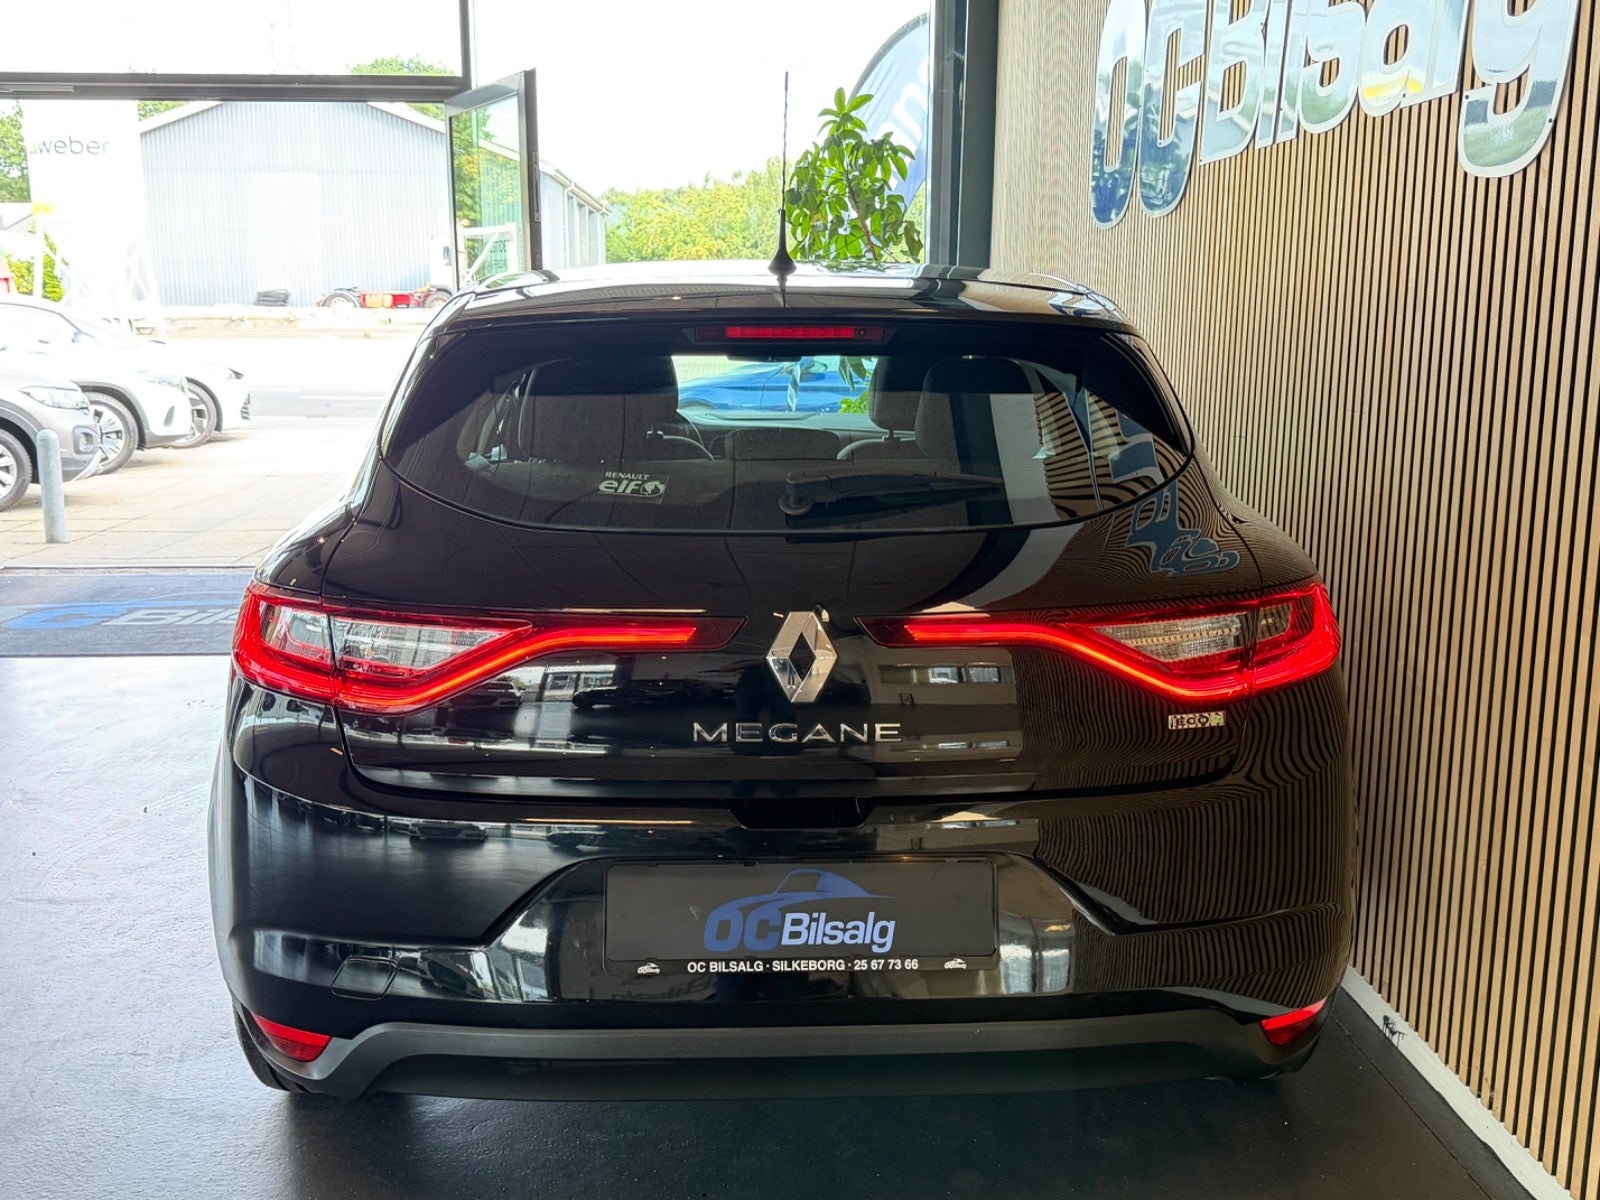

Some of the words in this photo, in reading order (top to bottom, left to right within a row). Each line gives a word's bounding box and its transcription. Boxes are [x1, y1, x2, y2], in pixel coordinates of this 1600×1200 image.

[38, 136, 110, 155] weber
[605, 471, 650, 480] RENAULT
[599, 480, 642, 494] elf
[693, 722, 902, 743] MEGANE
[687, 961, 706, 973] OC
[709, 960, 764, 973] BILSALG
[772, 959, 845, 972] SILKEBORG
[853, 959, 868, 971] 25
[871, 959, 885, 970] 67
[888, 958, 902, 970] 73
[904, 958, 919, 970] 66
